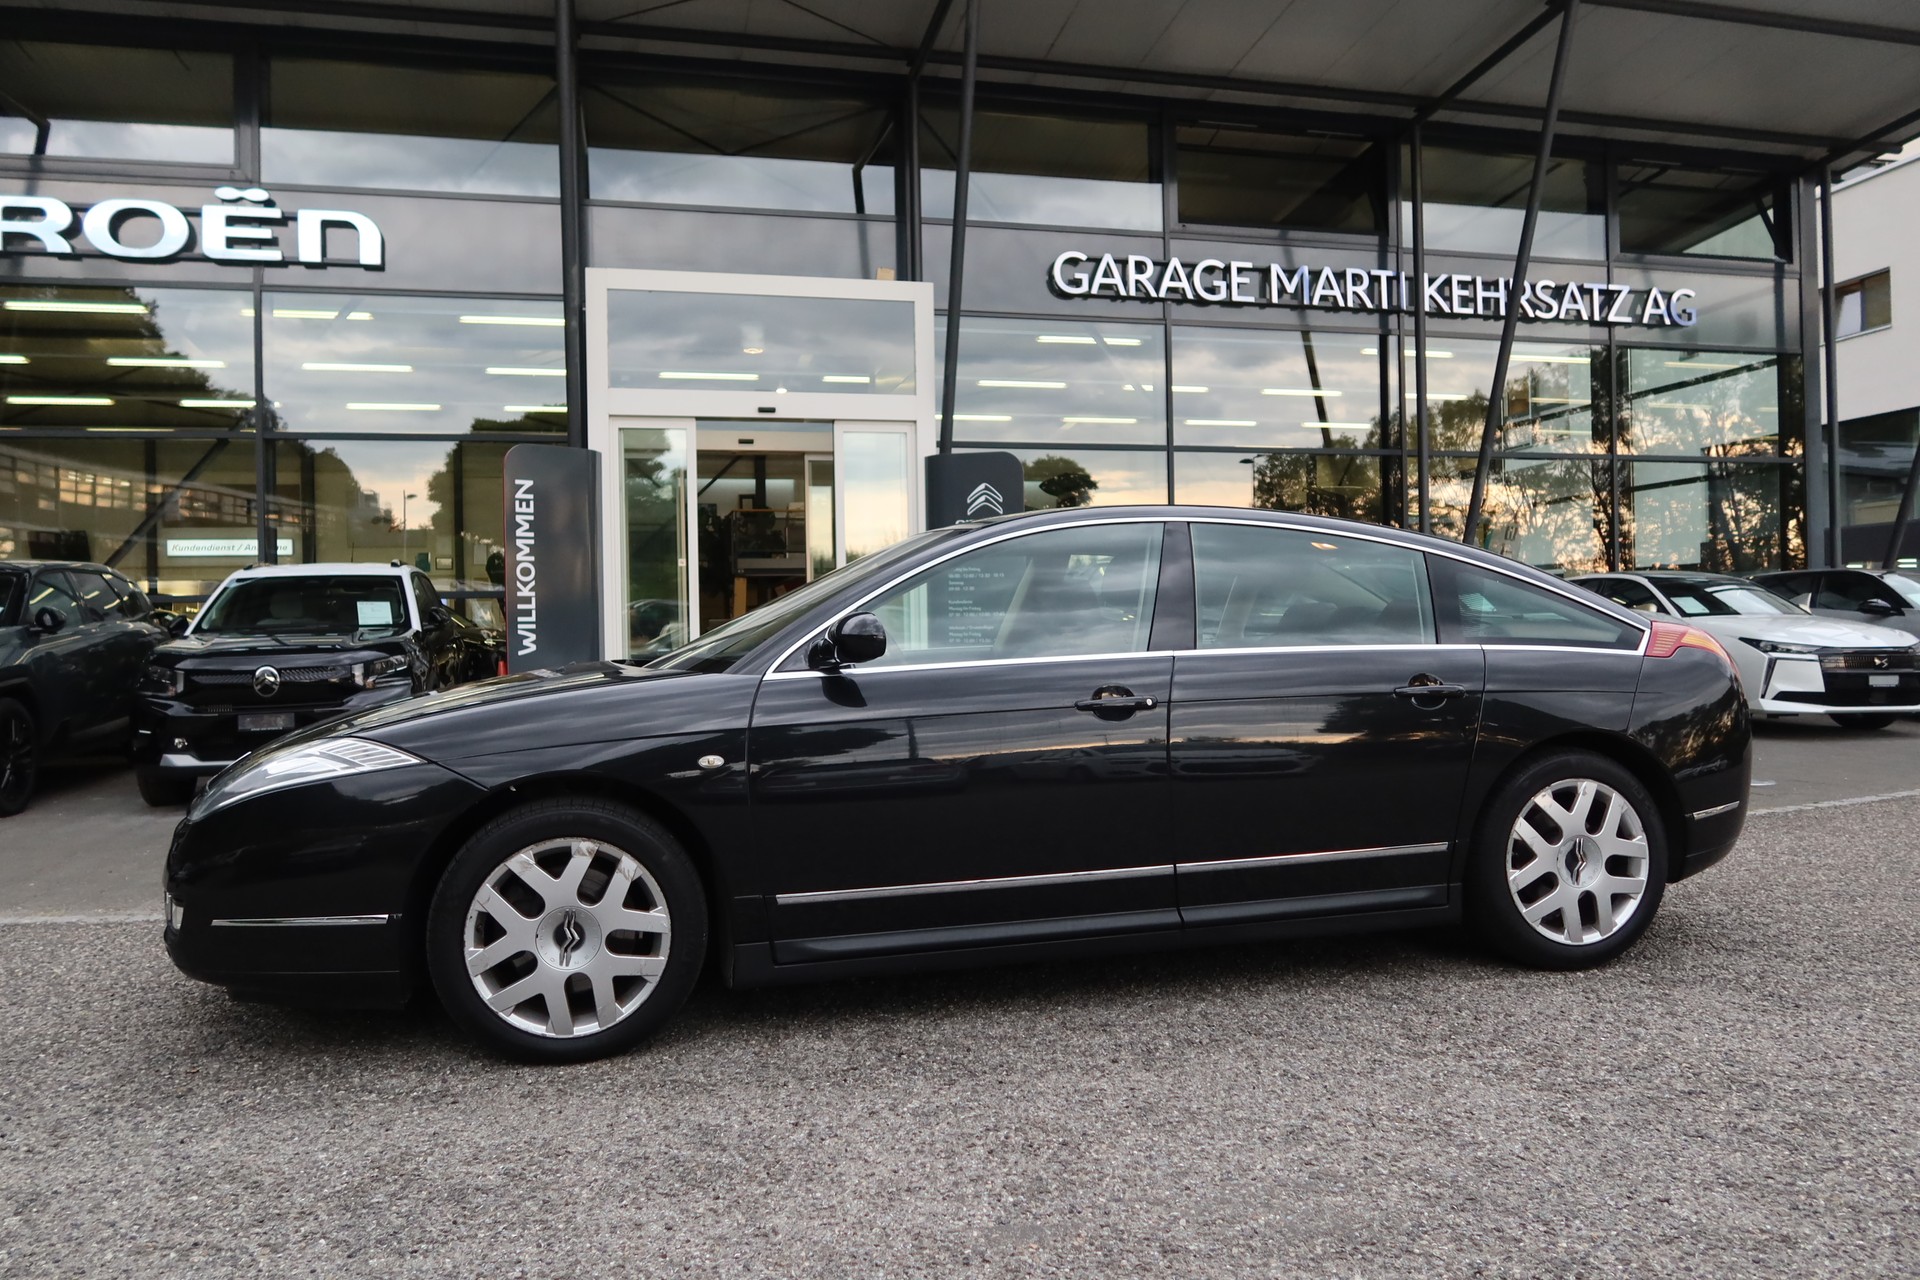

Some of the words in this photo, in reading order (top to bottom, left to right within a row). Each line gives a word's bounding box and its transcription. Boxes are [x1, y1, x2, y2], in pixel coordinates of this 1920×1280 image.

[1052, 250, 1256, 303] GARAGE
[1270, 262, 1407, 311] MARTI
[1642, 286, 1698, 328] AG
[171, 544, 235, 552] Kundendienst
[514, 479, 537, 657] WILLKOMMEN
